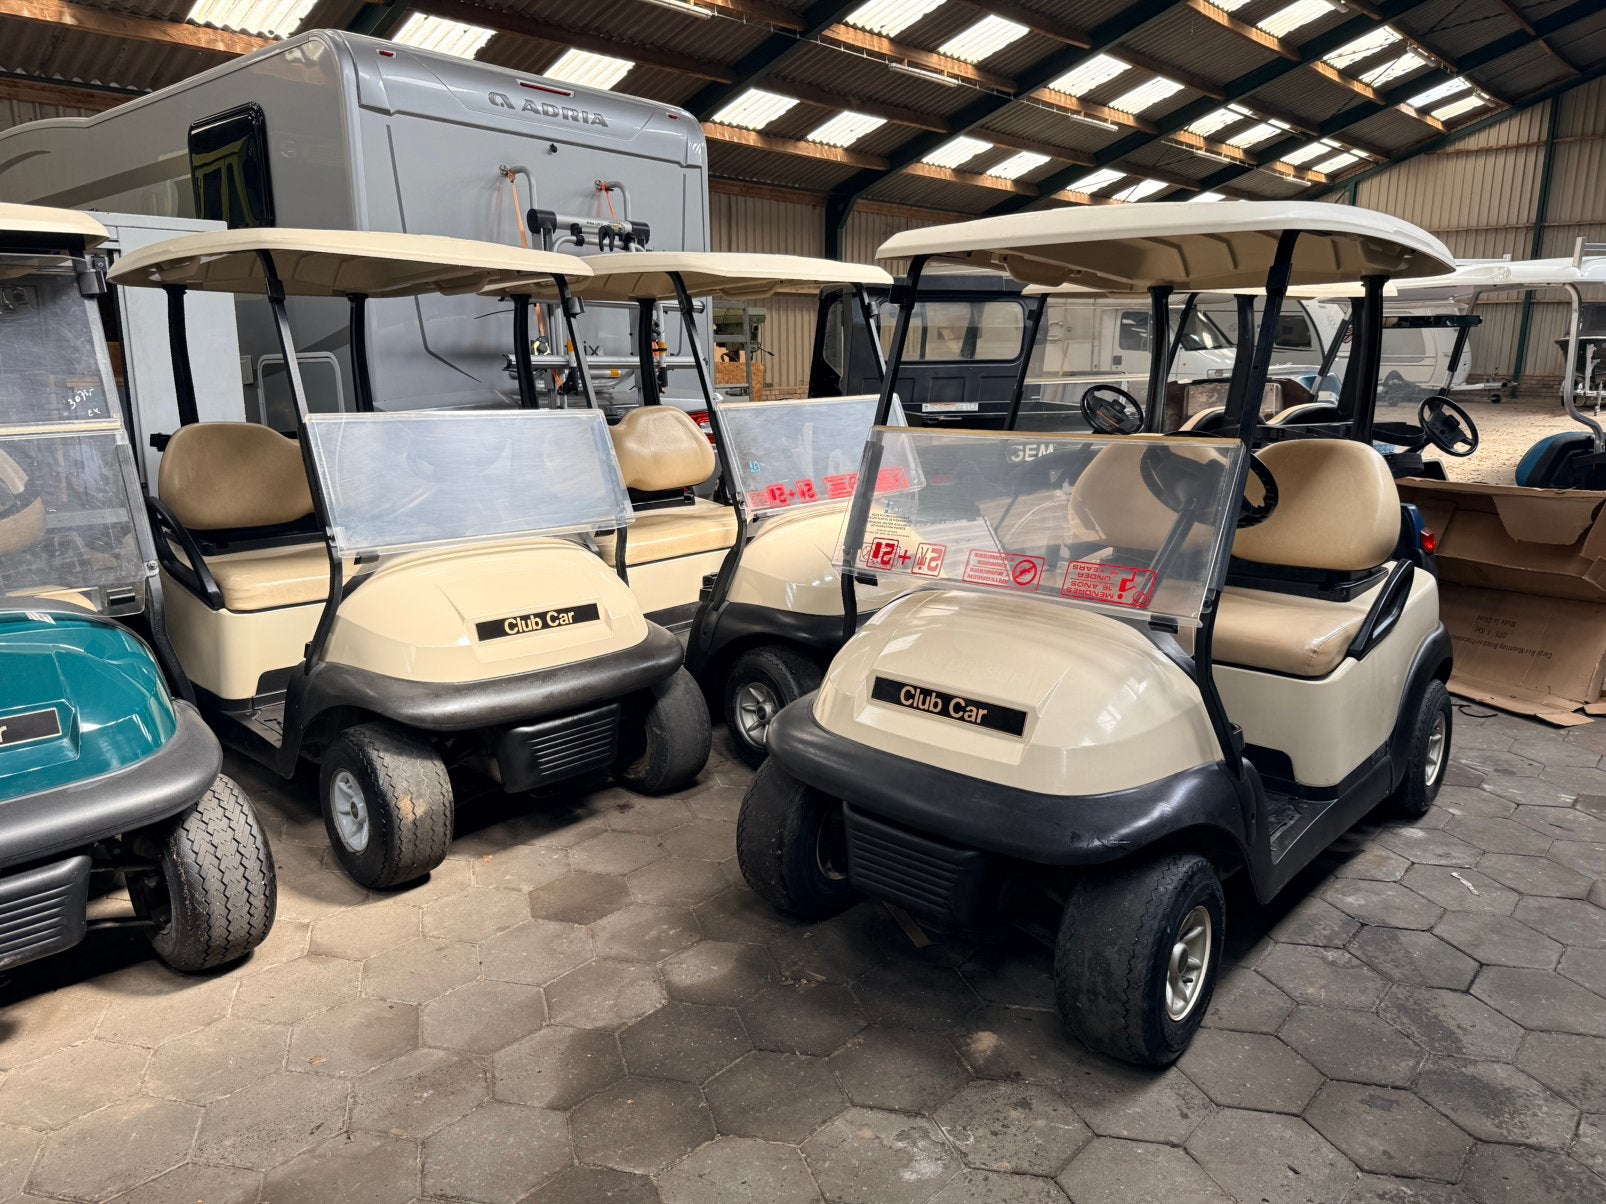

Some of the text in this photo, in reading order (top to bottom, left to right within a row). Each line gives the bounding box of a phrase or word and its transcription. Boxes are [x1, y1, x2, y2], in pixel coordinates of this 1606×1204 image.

[521, 99, 609, 128] ADRIA
[1072, 564, 1105, 574] YEARS
[1077, 573, 1111, 582] UNDER
[1066, 586, 1115, 600] MENORES
[504, 610, 575, 635] Club Car
[900, 685, 988, 724] Club Car
